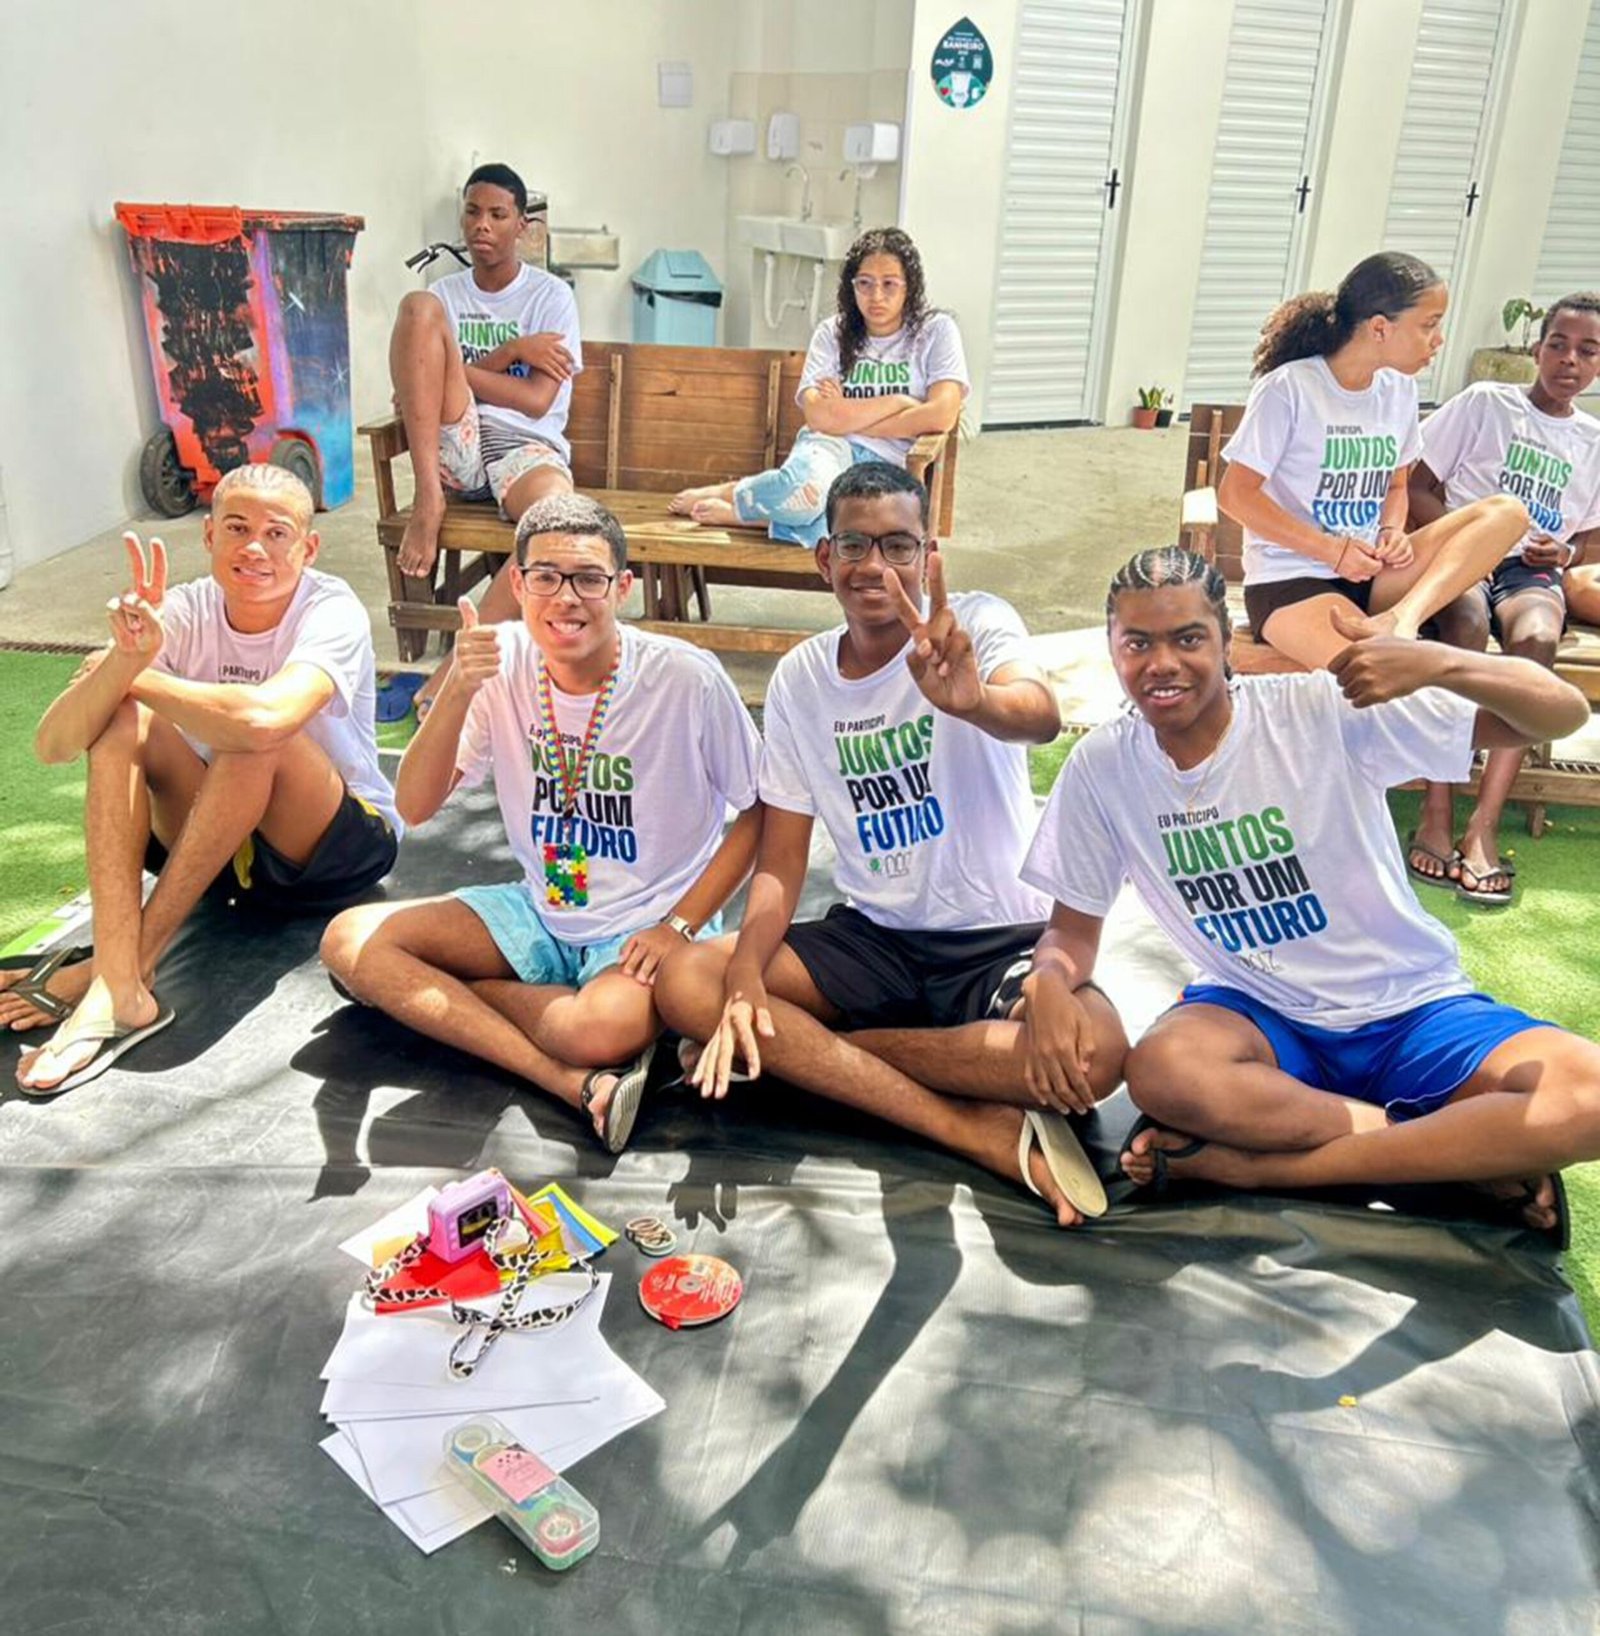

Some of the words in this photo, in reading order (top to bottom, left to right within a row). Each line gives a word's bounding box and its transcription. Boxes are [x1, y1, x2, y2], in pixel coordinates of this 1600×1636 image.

[1320, 435, 1397, 470] JUNTOS
[1504, 443, 1572, 488] JUNTOS
[1316, 471, 1357, 499] POR
[1499, 470, 1534, 499] POR
[1312, 500, 1379, 527] FUTUR
[834, 720, 845, 732] EU
[835, 715, 934, 776] JUNTOS
[585, 793, 634, 828] UM
[846, 774, 906, 813] POR
[1157, 814, 1171, 828] EU
[1161, 806, 1294, 876] JUNTOS
[1175, 872, 1248, 915] POR
[1243, 854, 1310, 902] UM
[1194, 893, 1327, 953] FUTURO
